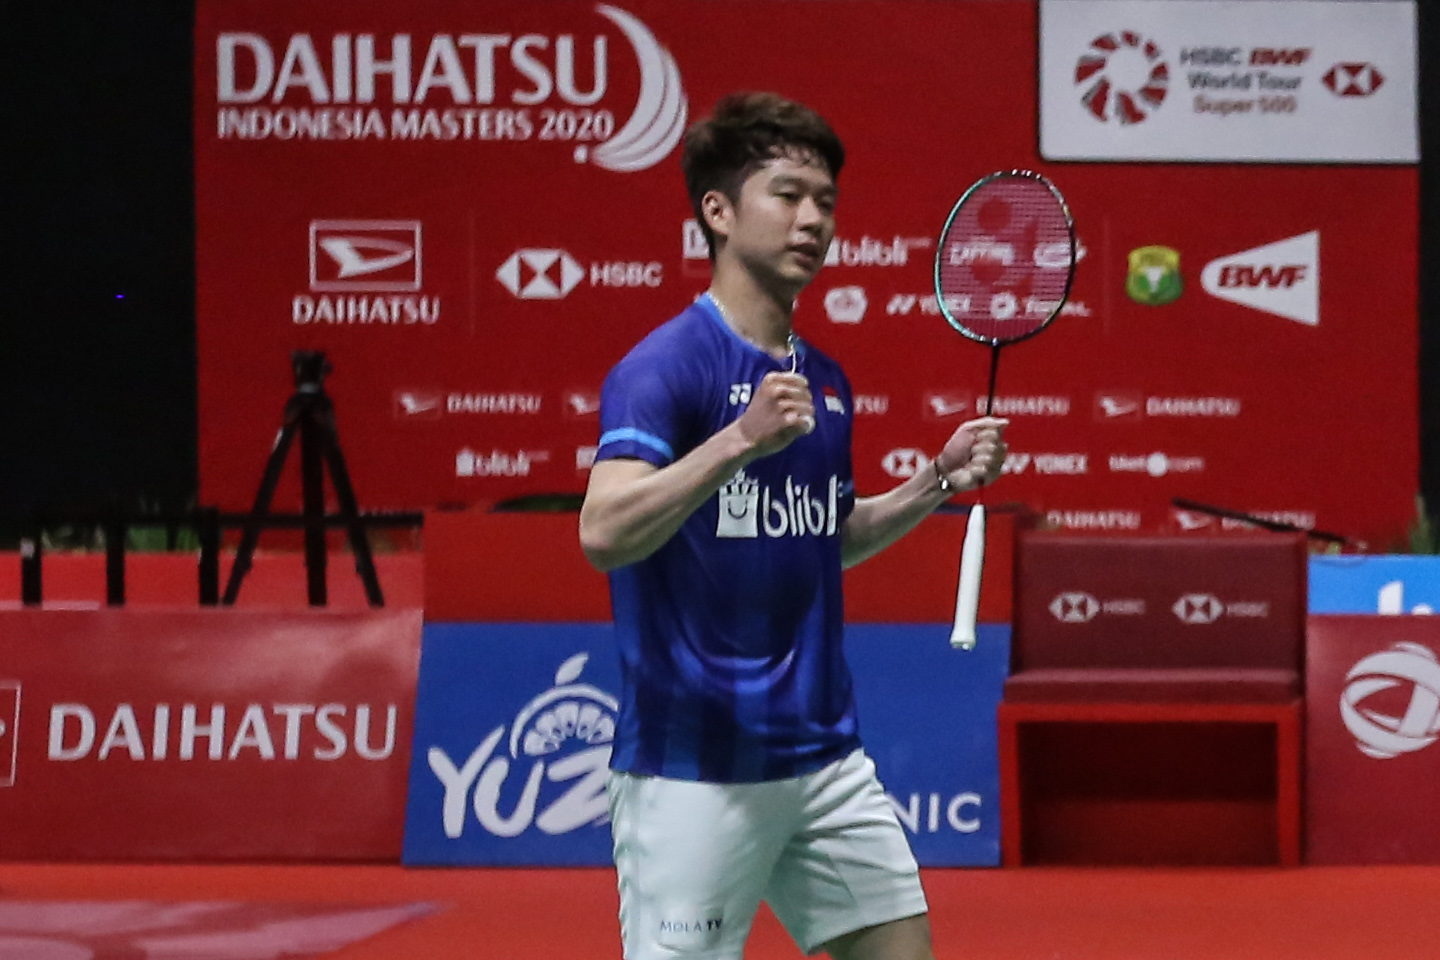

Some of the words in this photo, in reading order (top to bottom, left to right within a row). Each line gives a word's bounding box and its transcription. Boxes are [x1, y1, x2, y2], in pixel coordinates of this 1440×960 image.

[216, 32, 608, 105] DAIHATSU
[1179, 47, 1241, 66] HSBC
[1249, 47, 1312, 66] BWF
[217, 108, 386, 140] INDONESIA
[391, 108, 533, 140] MASTERS
[538, 109, 615, 140] 2020
[590, 262, 663, 288] HSBC
[1217, 265, 1308, 288] BWF
[292, 296, 441, 325] DAIHATSU
[447, 393, 543, 414] DAIHATSU
[762, 473, 840, 538] blibl
[48, 703, 397, 762] DAIHATSU
[427, 723, 614, 838] YUZ
[706, 918, 723, 932] TV
